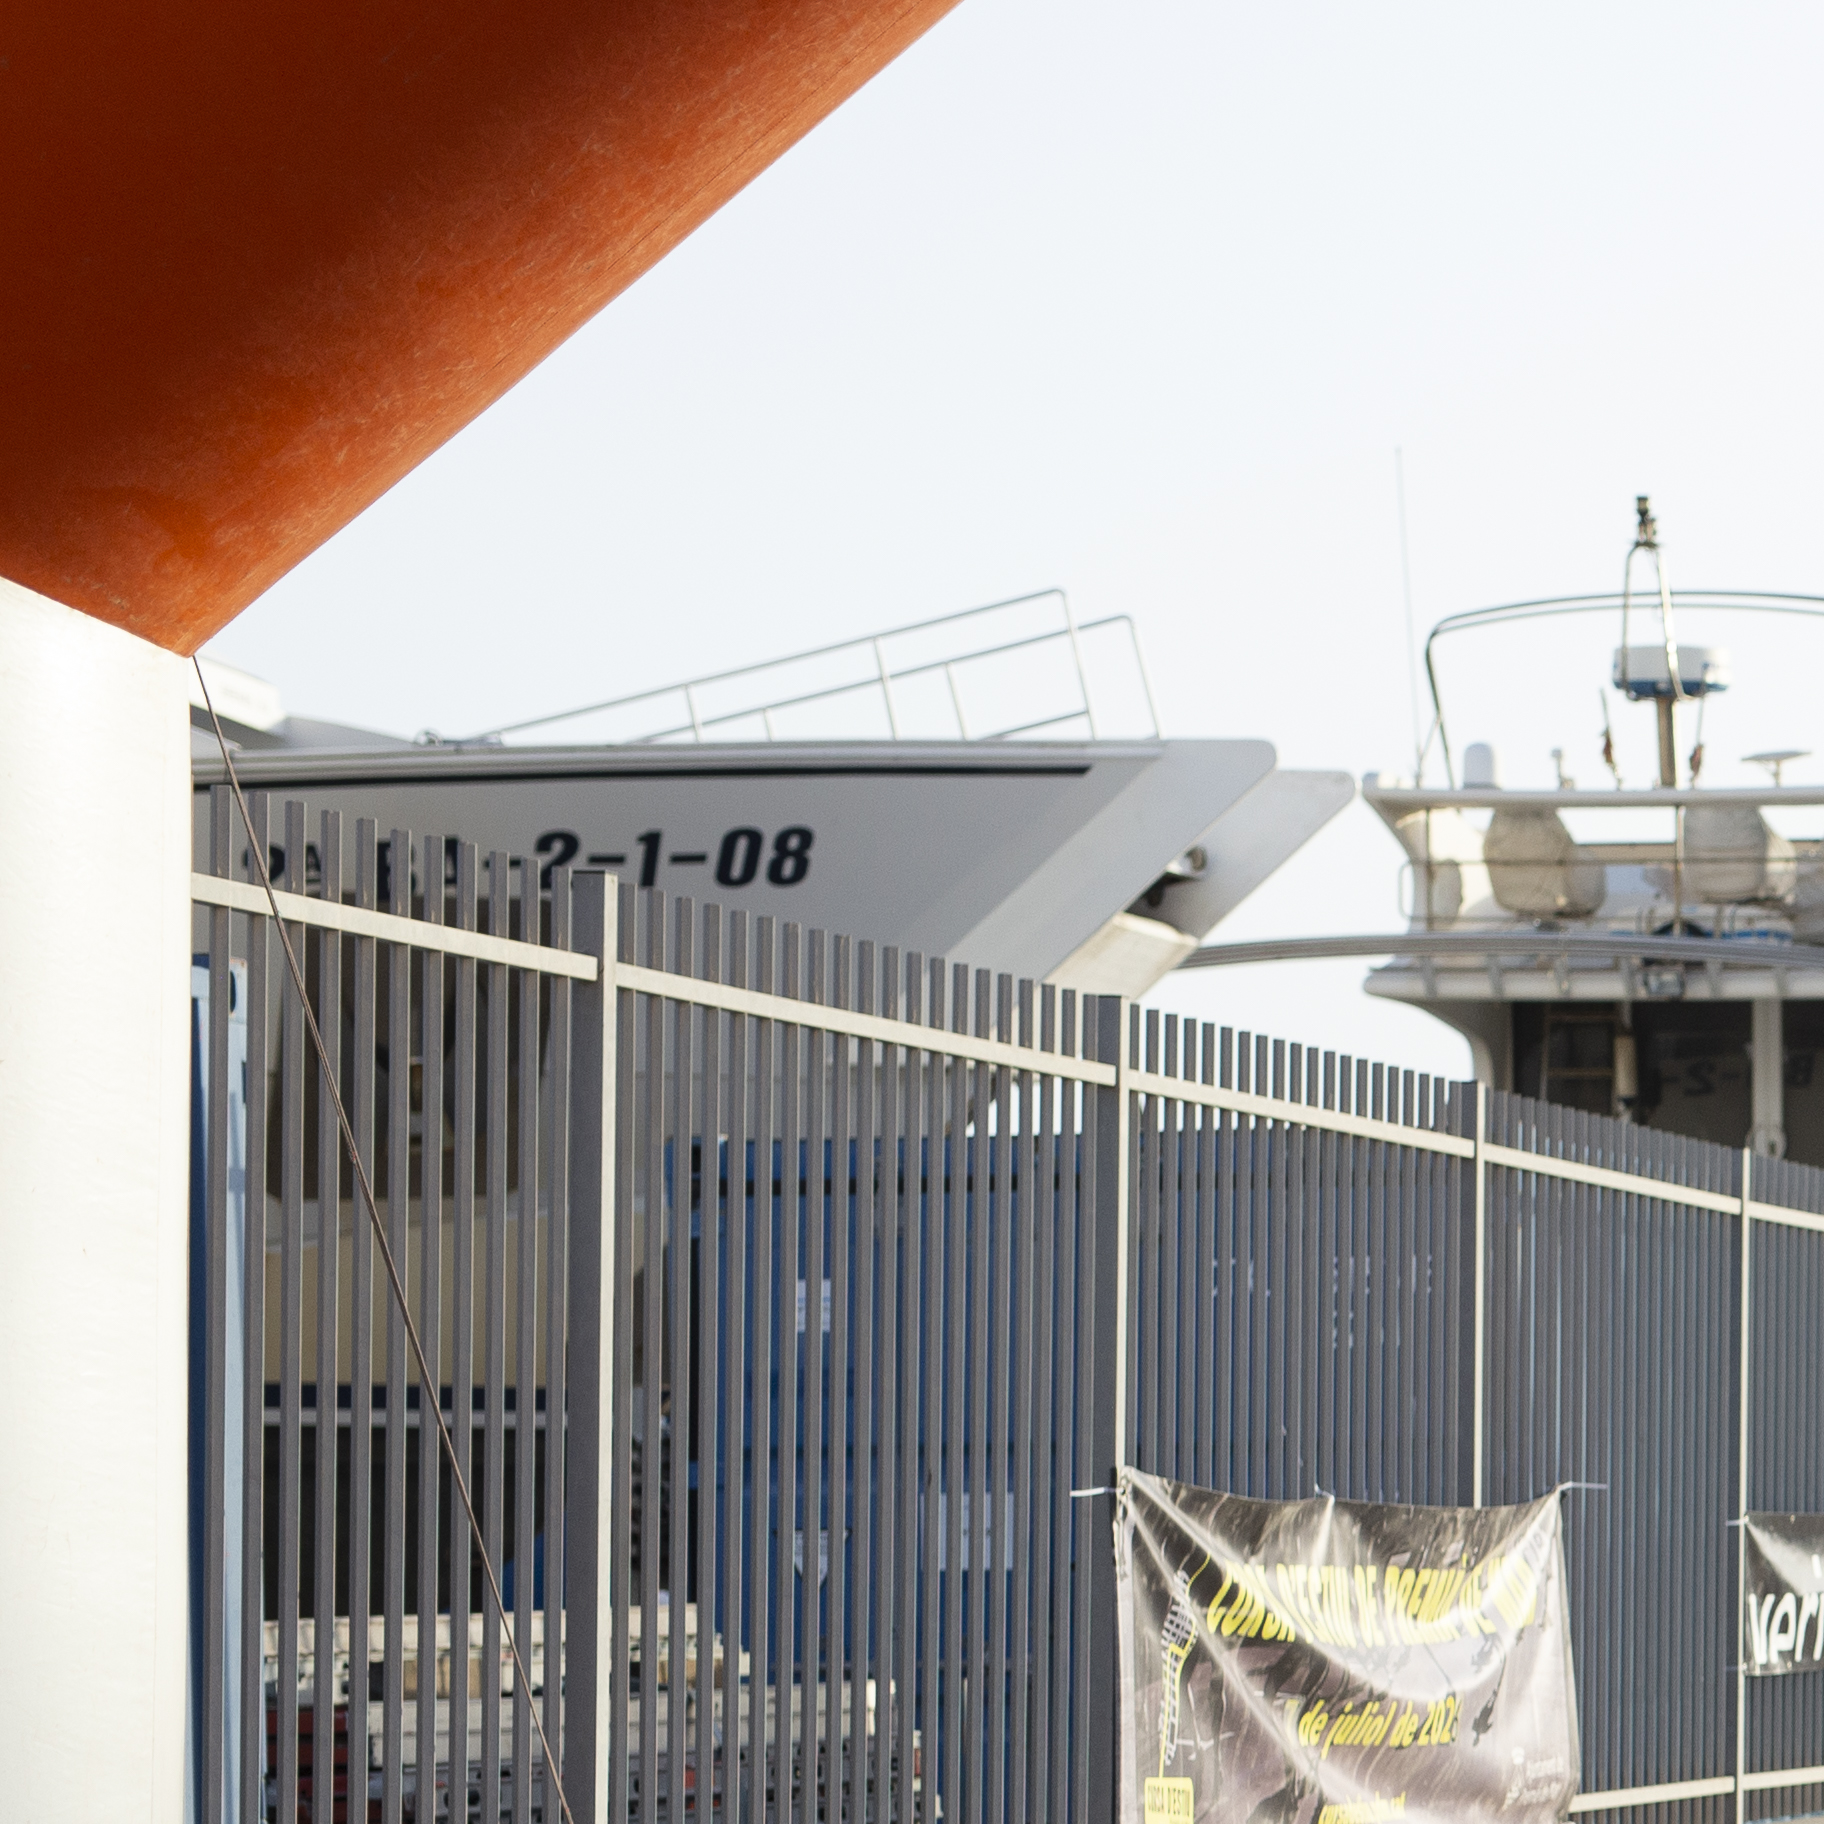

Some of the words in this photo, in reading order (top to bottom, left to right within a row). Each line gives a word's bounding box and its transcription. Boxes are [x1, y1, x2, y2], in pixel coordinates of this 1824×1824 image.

[1354, 1564, 1386, 1648] DE
[1299, 1700, 1329, 1746] de
[1321, 1701, 1398, 1760] juliol
[1389, 1700, 1419, 1748] de
